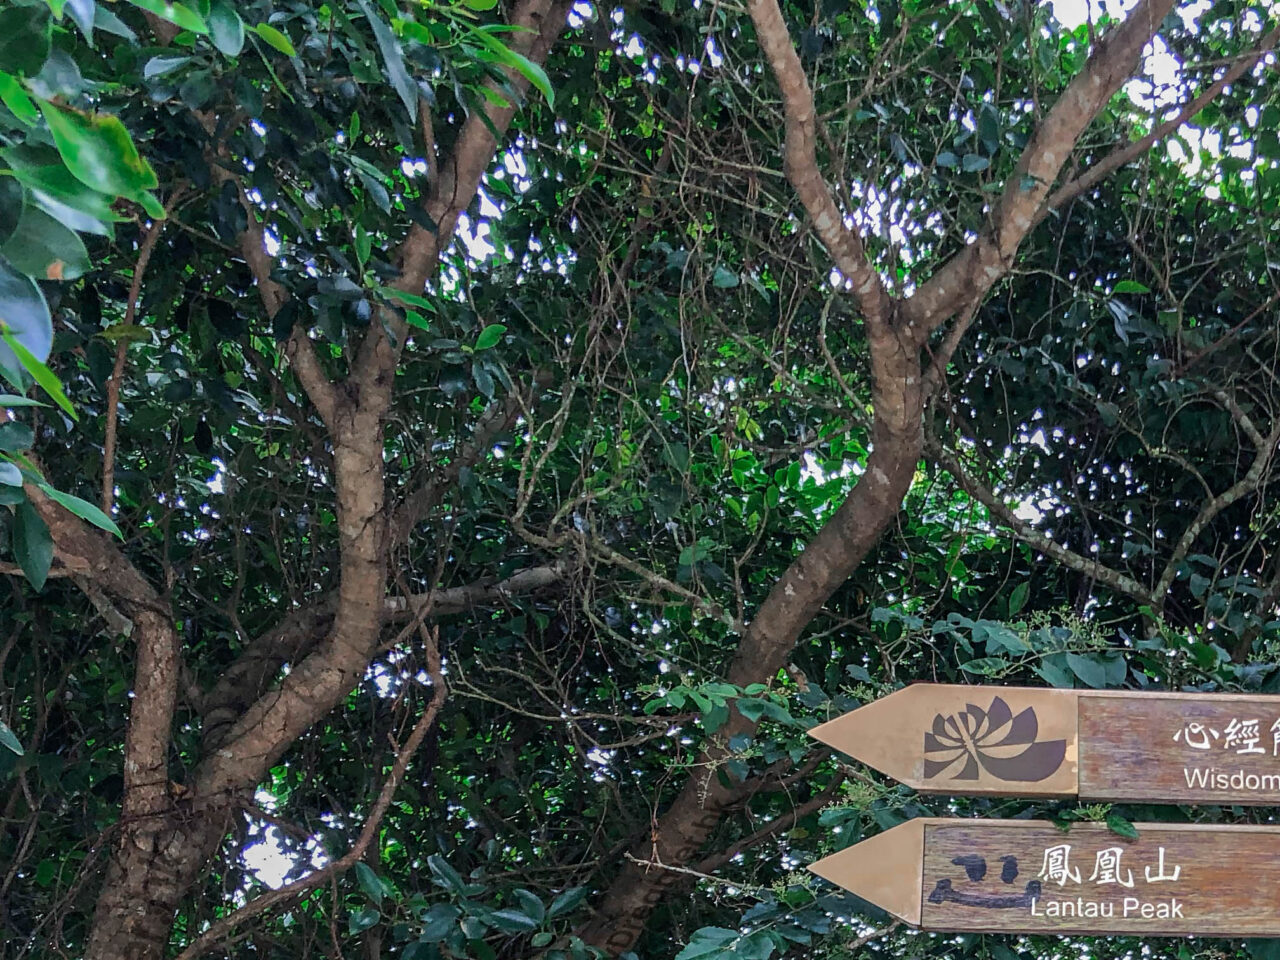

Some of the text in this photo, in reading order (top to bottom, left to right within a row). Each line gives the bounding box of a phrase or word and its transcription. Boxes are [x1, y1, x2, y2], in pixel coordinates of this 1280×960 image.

[1037, 843, 1182, 887] 鳳凰山
[1030, 895, 1184, 921] Lantau Peak
